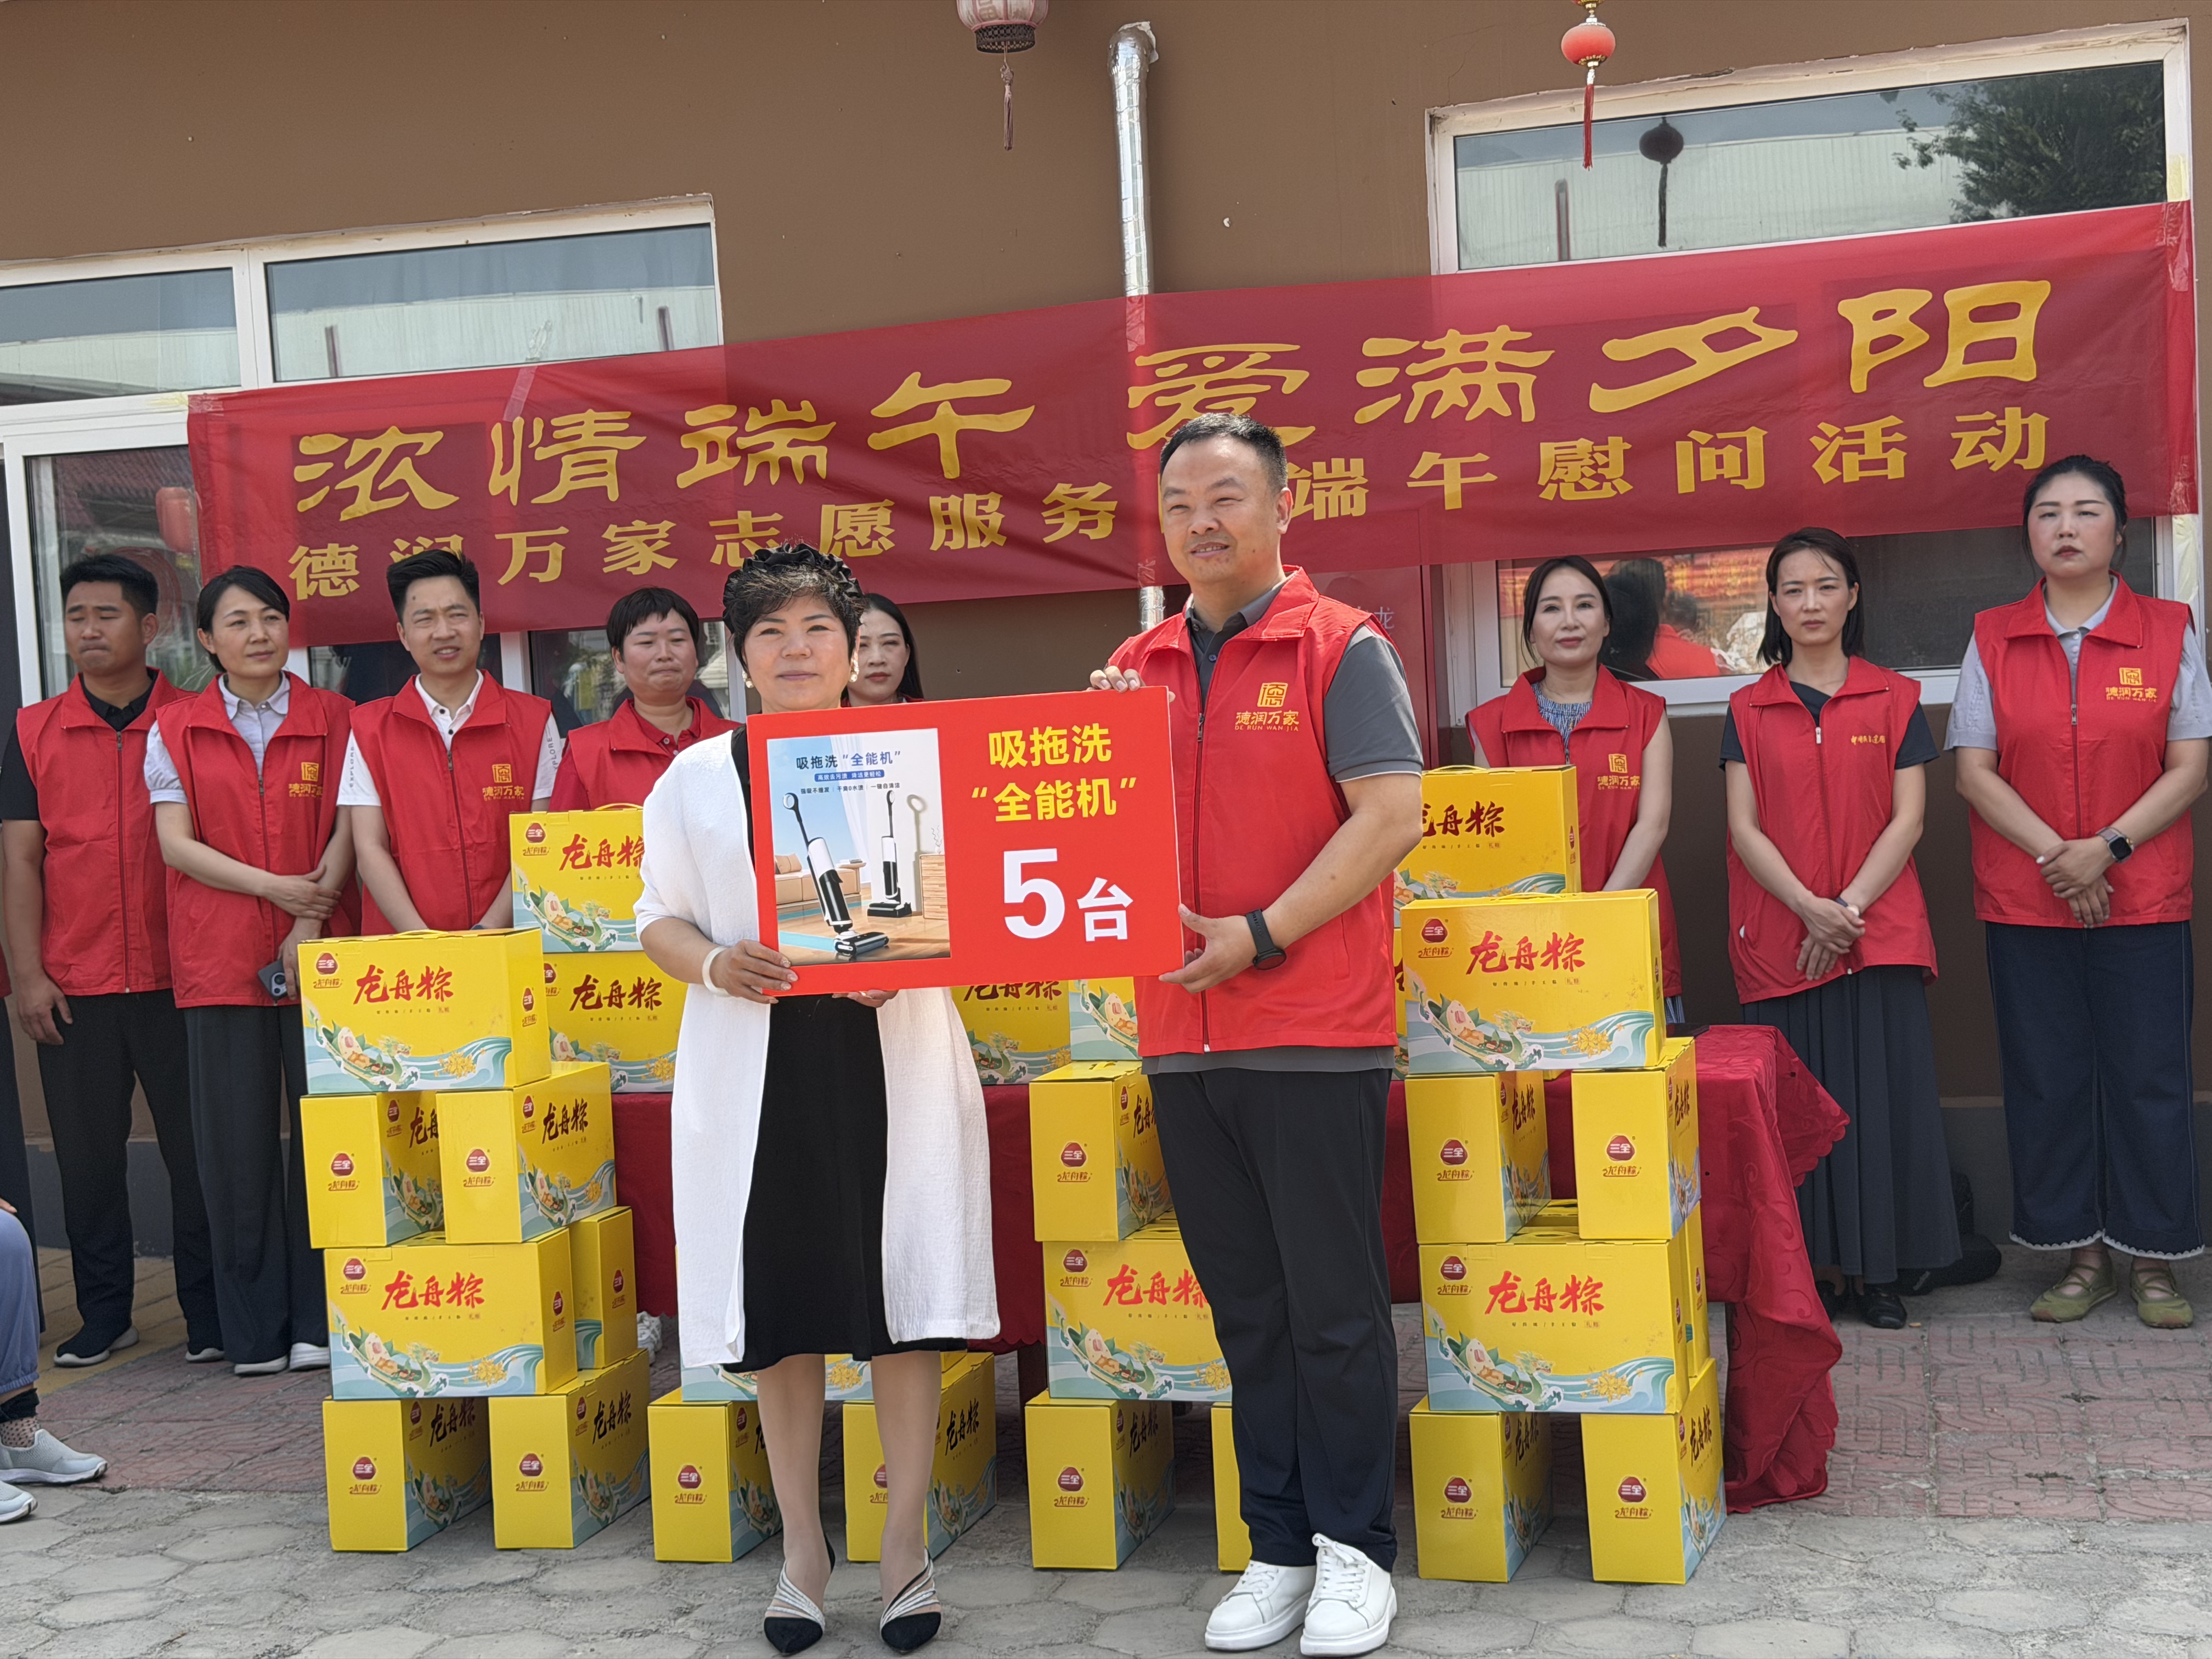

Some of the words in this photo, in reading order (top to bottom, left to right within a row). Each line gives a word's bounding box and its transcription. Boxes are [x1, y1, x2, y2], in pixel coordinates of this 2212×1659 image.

[293, 370, 1035, 522] 浓情端午
[1126, 279, 2051, 449] 爱满夕阳
[289, 406, 2049, 601] 德万家志愿服务端午慰问活动
[1235, 709, 1300, 726] 德润万家
[988, 723, 1112, 769] 吸拖洗
[527, 828, 544, 838] 三全
[1003, 848, 1134, 942] 5台
[1424, 926, 1444, 936] 三全
[1465, 930, 1586, 975] 龙舟粽
[318, 959, 335, 969] 三全
[353, 964, 454, 1005] 龙舟粽
[569, 974, 663, 1012] 龙舟粽
[541, 1097, 589, 1145] 龙舟粽
[1443, 1147, 1464, 1159] 三全
[1609, 1143, 1630, 1154] 三全
[469, 1155, 487, 1166] 三全
[1063, 1150, 1083, 1160] 三全
[332, 1159, 352, 1170] 三全
[1065, 1256, 1085, 1267] 三全
[345, 1263, 363, 1274] 三全
[1443, 1263, 1464, 1274] 三全
[381, 1269, 485, 1310] 龙舟粽
[1484, 1270, 1605, 1316] 龙舟粽
[355, 1464, 373, 1474] 三全
[521, 1460, 540, 1471] 三全
[1061, 1474, 1080, 1485] 三全
[1447, 1485, 1468, 1497] 三全
[1621, 1485, 1642, 1497] 三全
